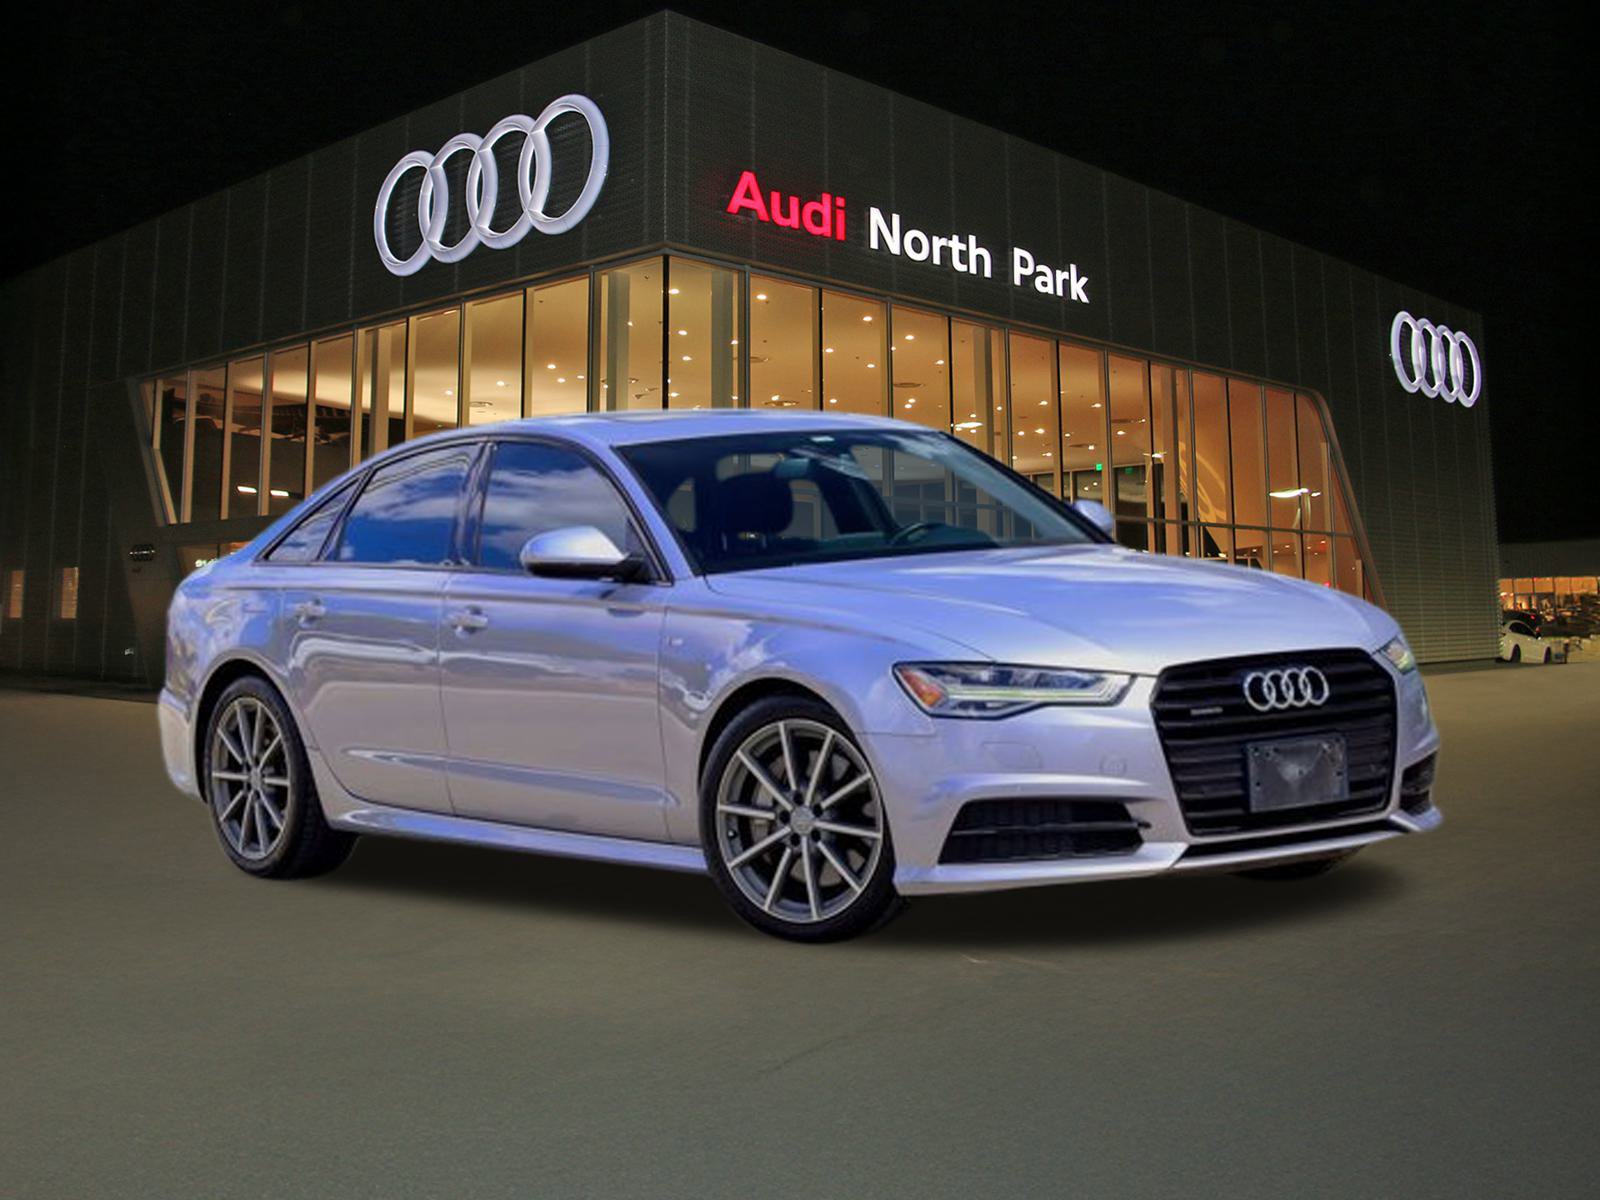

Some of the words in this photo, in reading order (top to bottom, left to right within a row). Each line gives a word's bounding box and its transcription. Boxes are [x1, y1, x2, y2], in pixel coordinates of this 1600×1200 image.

[727, 171, 846, 241] Audi
[869, 206, 992, 278] North
[1013, 246, 1090, 303] Park
